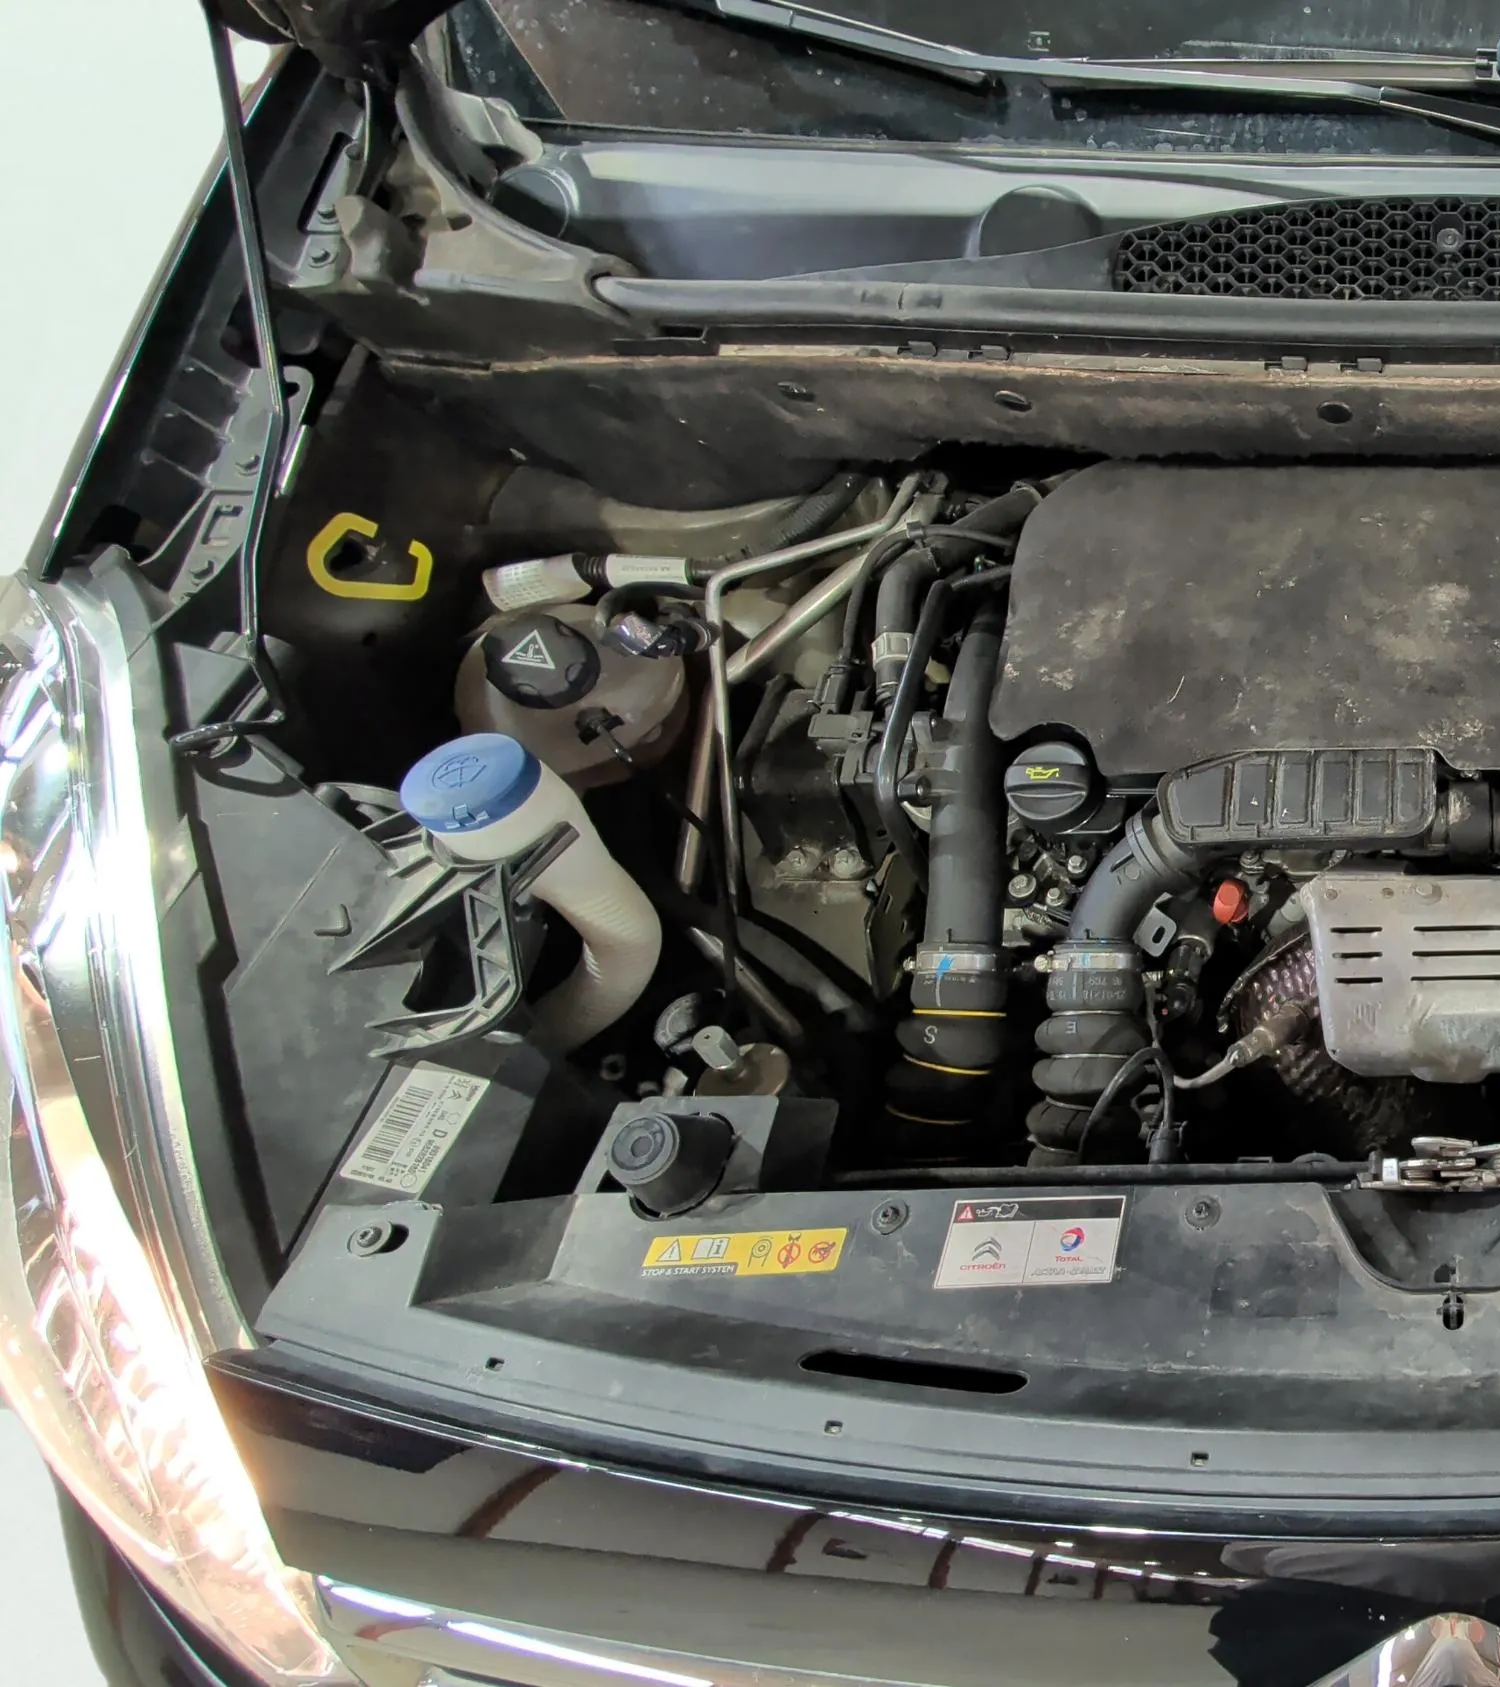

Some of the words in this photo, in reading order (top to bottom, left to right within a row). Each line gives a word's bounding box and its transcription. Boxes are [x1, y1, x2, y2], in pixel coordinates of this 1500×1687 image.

[924, 1025, 938, 1044] S
[432, 1128, 448, 1139] D
[1055, 1255, 1083, 1263] TOTAL
[640, 1268, 665, 1277] STOP
[673, 1267, 699, 1275] START
[701, 1265, 735, 1274] SYSTEM
[960, 1262, 1006, 1271] CITROËN
